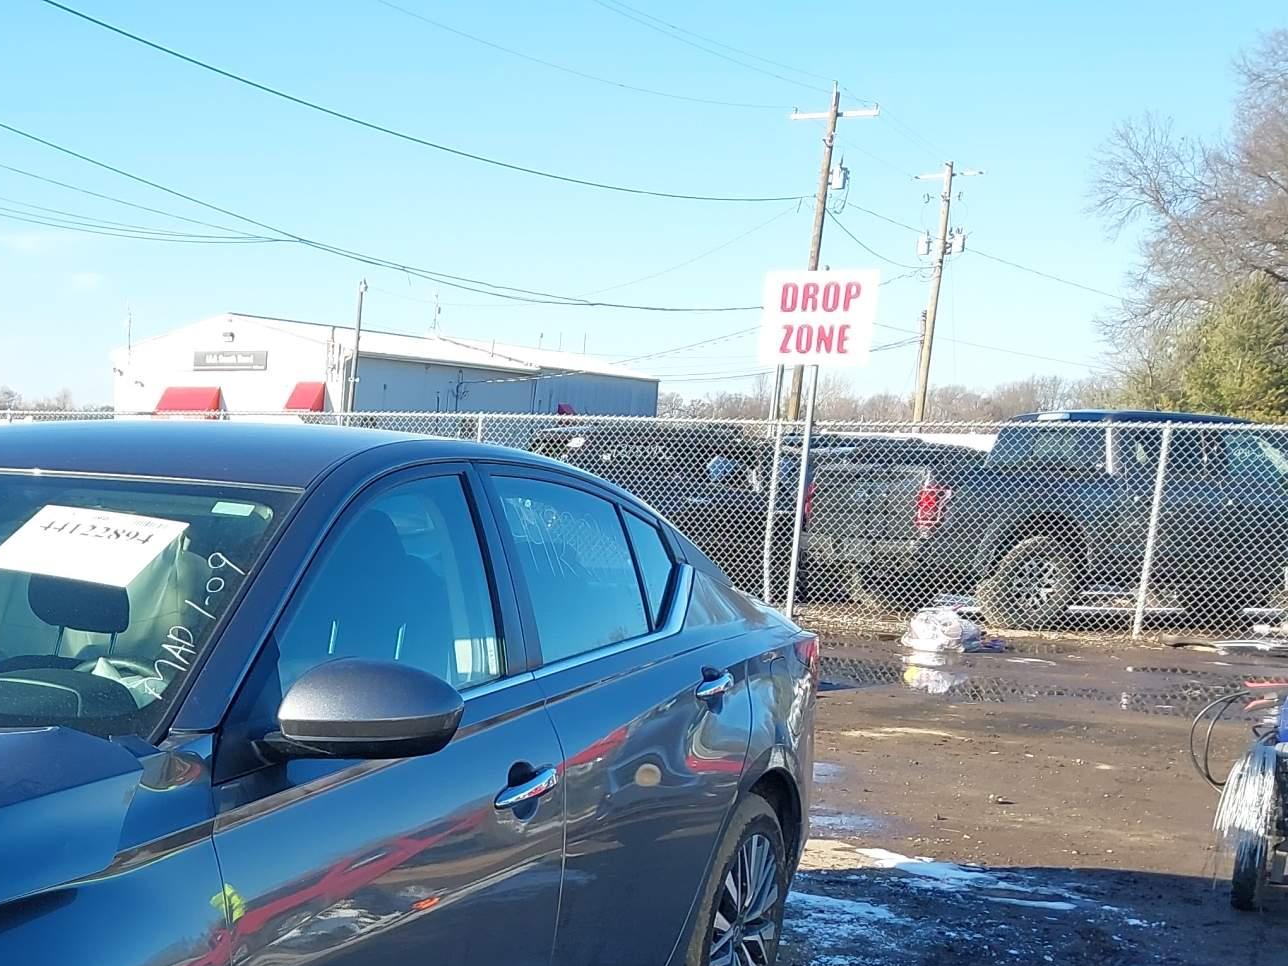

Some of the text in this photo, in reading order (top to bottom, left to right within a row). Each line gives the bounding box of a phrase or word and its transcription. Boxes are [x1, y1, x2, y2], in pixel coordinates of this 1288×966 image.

[780, 281, 862, 312] DROP
[779, 324, 851, 354] ZONE
[40, 519, 154, 544] 44122894
[144, 552, 246, 700] MAD 1-09
